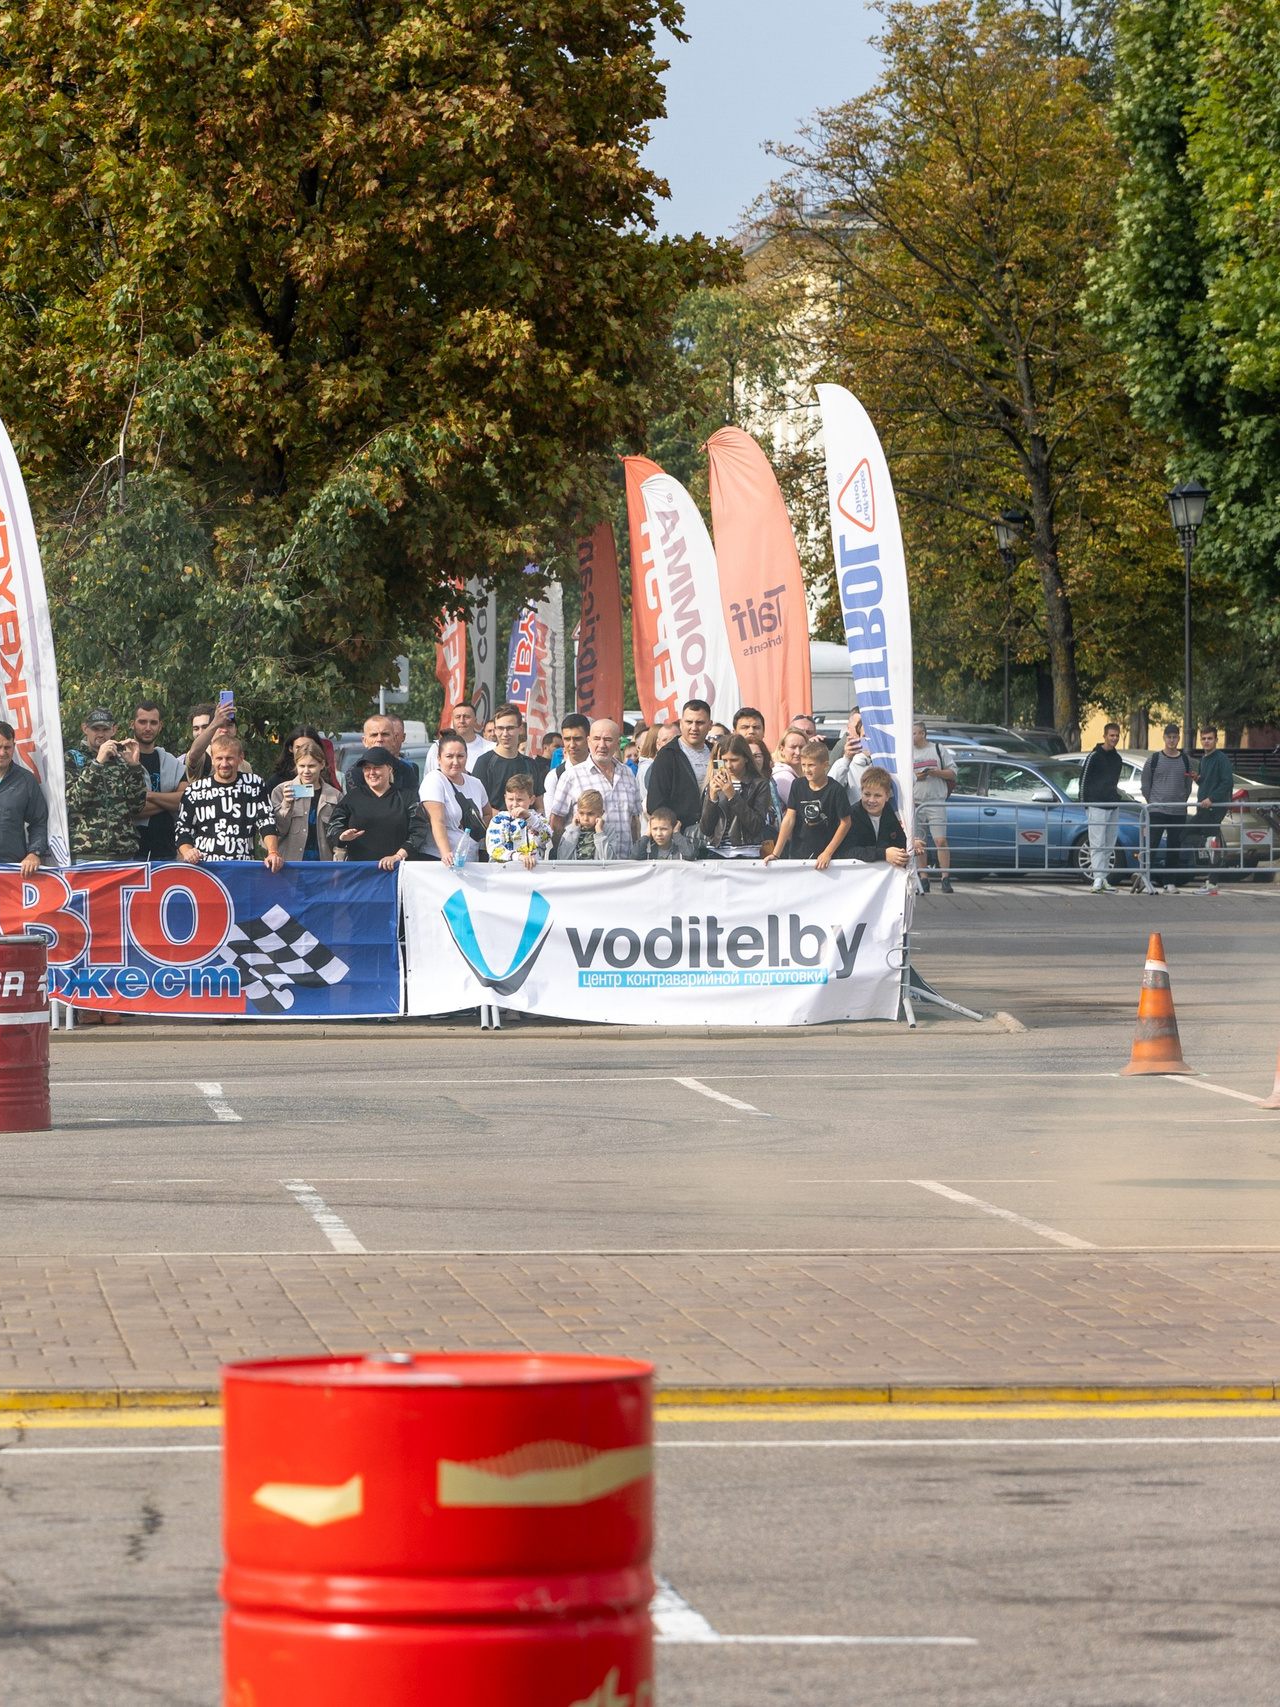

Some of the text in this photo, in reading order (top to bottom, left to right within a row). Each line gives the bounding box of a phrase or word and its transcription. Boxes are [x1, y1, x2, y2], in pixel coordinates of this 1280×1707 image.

[565, 913, 868, 980] voditel.by
[582, 970, 824, 988] центр контраварийной подготовки
